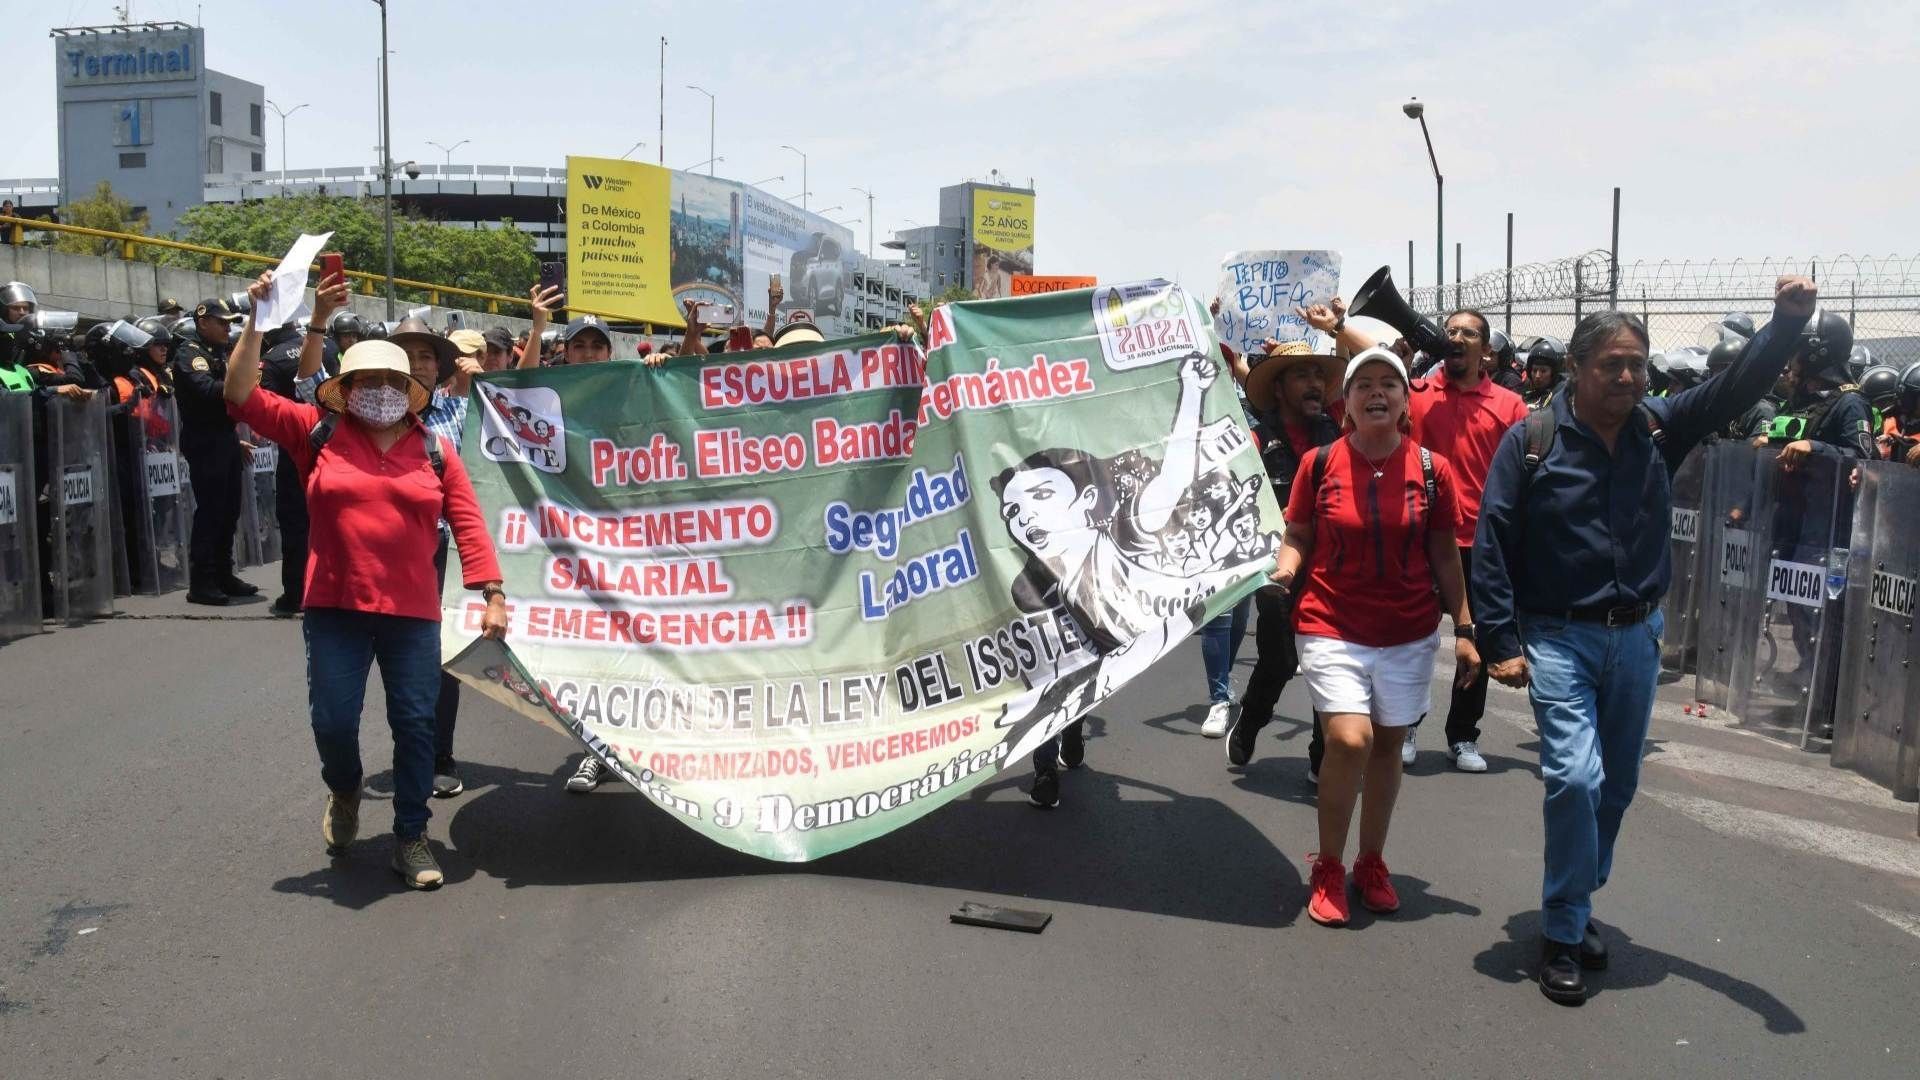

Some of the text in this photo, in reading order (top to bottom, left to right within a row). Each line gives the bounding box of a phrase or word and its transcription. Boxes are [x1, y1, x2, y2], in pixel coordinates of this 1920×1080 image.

[67, 44, 190, 77] Terminal
[121, 99, 140, 145] 1
[604, 176, 632, 187] Western
[582, 203, 641, 219] De México
[582, 220, 645, 235] a Colombia
[982, 215, 1028, 230] 25 AÑOS
[579, 236, 636, 248] y muchos
[581, 249, 644, 264] países más
[1115, 318, 1192, 354] 2024
[1137, 350, 1156, 359] AÑOS
[1157, 343, 1194, 353] LUCHANDO
[703, 355, 853, 408] ESCUELA
[592, 357, 1093, 485] Profr. Eliseo Banda Fernández
[149, 463, 176, 486] POLICIA
[253, 453, 272, 471] OLICIA
[64, 474, 90, 500] POLICIA
[539, 504, 772, 548] INCREMENTO
[550, 557, 728, 596] SALARIAL
[1771, 566, 1821, 601] POLICIA
[1872, 573, 1916, 615] POLICIA
[527, 604, 776, 646] EMERGENCIA
[708, 687, 753, 731] DE
[766, 682, 810, 728] LA
[821, 675, 887, 723] LEY
[896, 653, 963, 712] DEL
[966, 607, 1082, 692] ISSSTE
[650, 750, 820, 780] ORGANIZADOS,
[713, 797, 745, 829] 9
[756, 740, 1009, 833] Democrática
